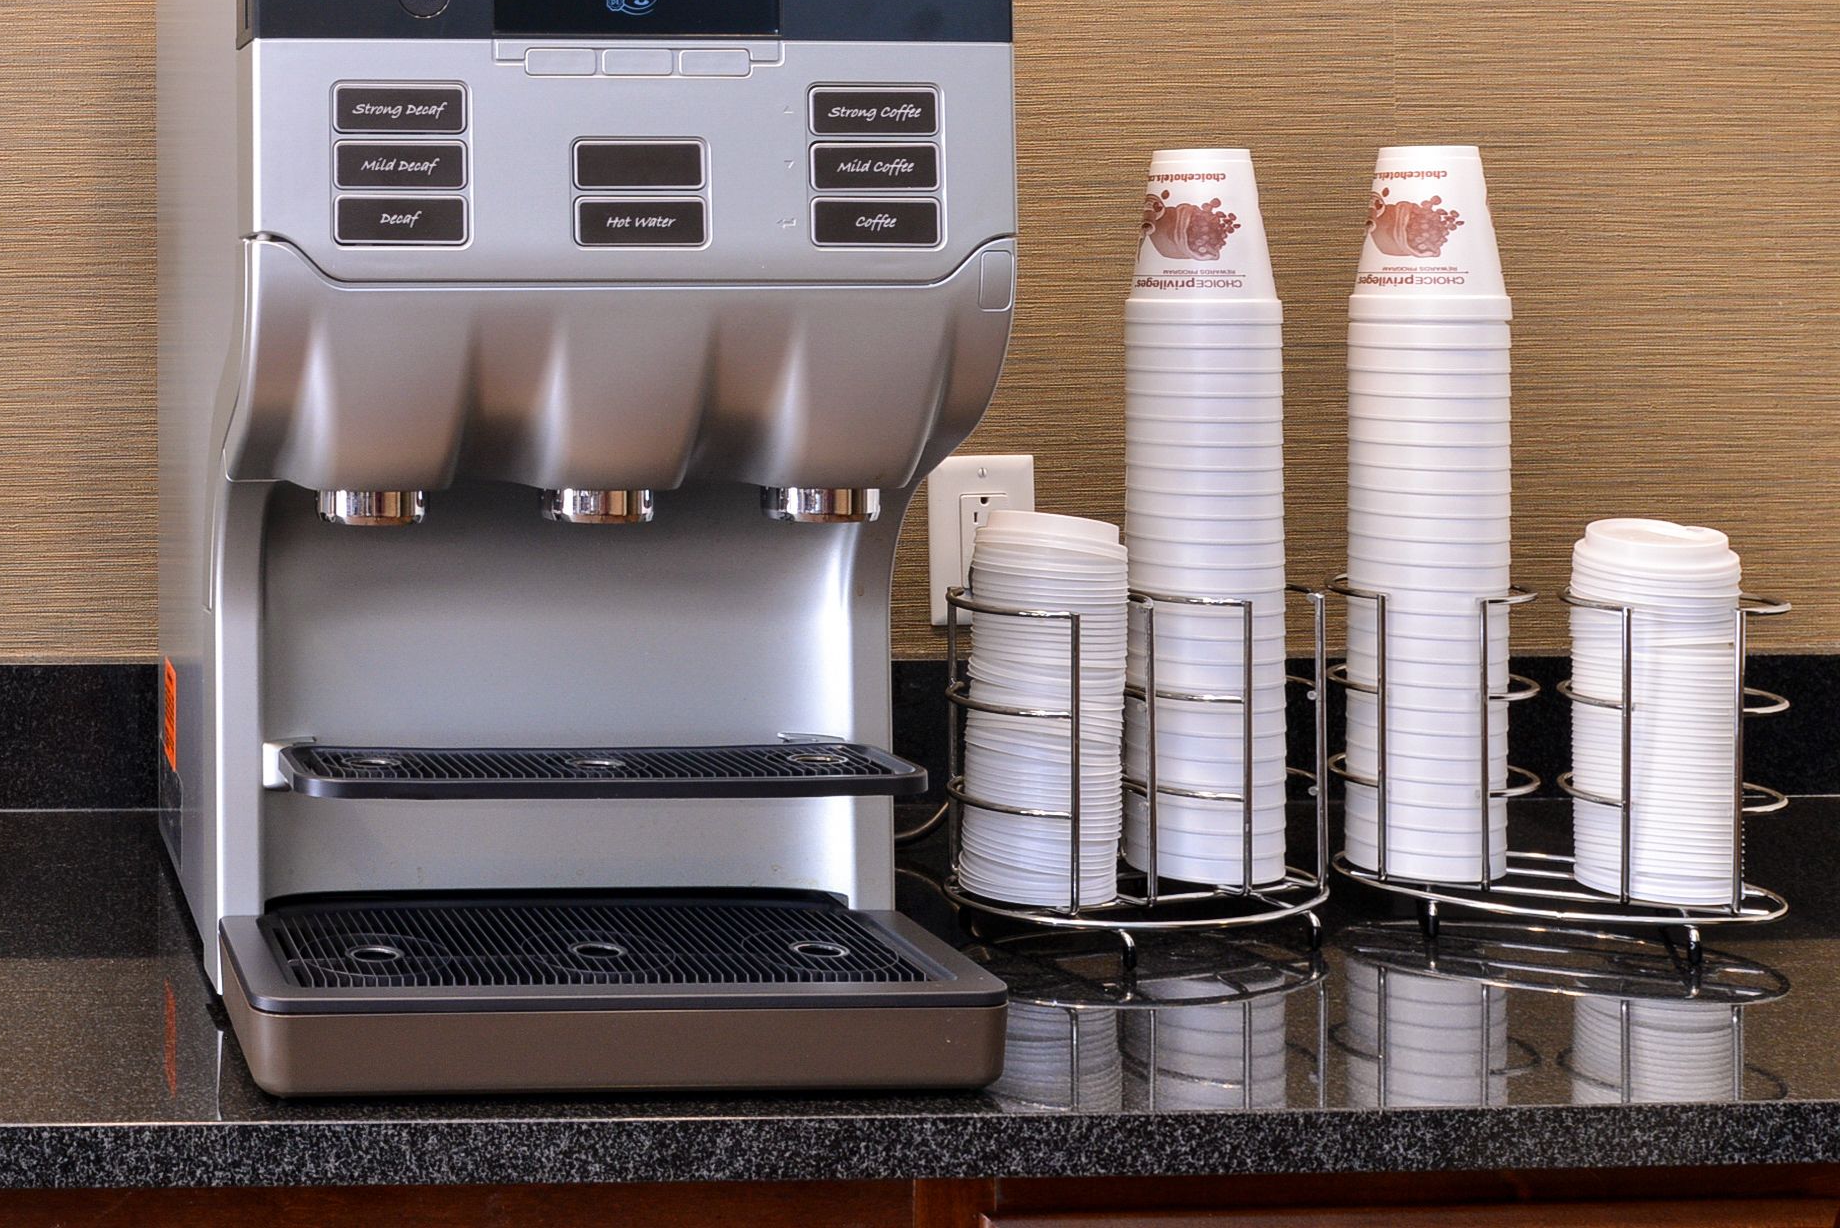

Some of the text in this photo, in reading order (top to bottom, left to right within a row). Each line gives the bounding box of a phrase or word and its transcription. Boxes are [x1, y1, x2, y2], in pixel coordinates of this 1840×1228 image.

[352, 102, 448, 119] Strong Decaf
[828, 104, 922, 122] Strong Coffee
[360, 157, 440, 176] Mild Decaf
[837, 159, 915, 176] Mild Coffee
[380, 211, 422, 228] Decaf
[606, 216, 677, 228] Hot Water
[856, 214, 898, 232] Coffee
